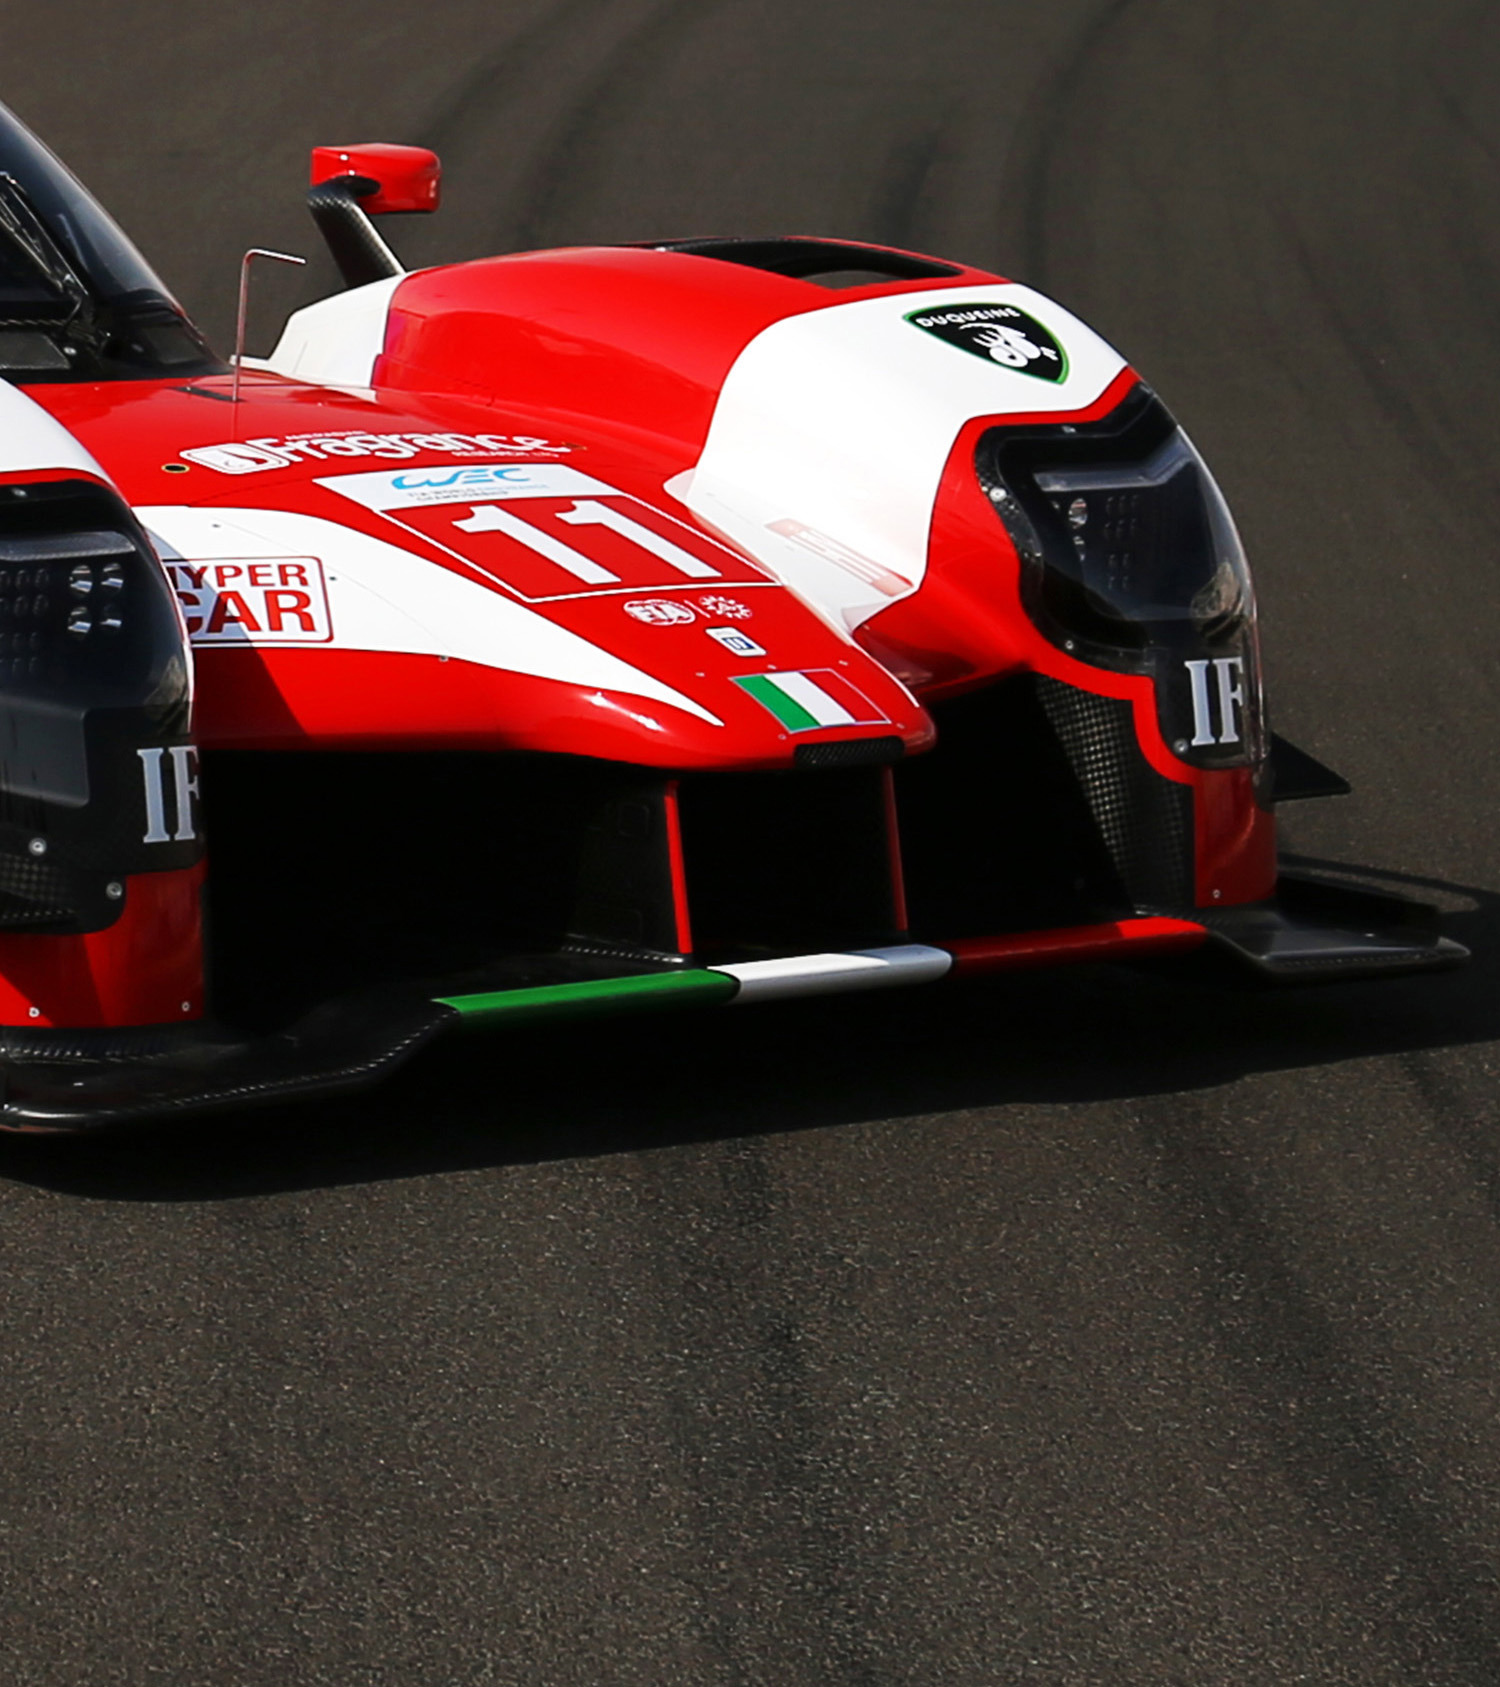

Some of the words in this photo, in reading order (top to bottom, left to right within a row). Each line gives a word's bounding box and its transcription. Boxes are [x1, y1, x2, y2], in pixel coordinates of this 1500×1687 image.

[915, 307, 1021, 327] DUQUEINE
[248, 431, 572, 461] Fragrance
[391, 467, 532, 490] WEC
[451, 498, 724, 585] 11
[1183, 656, 1244, 747] IF
[136, 743, 199, 843] IF
